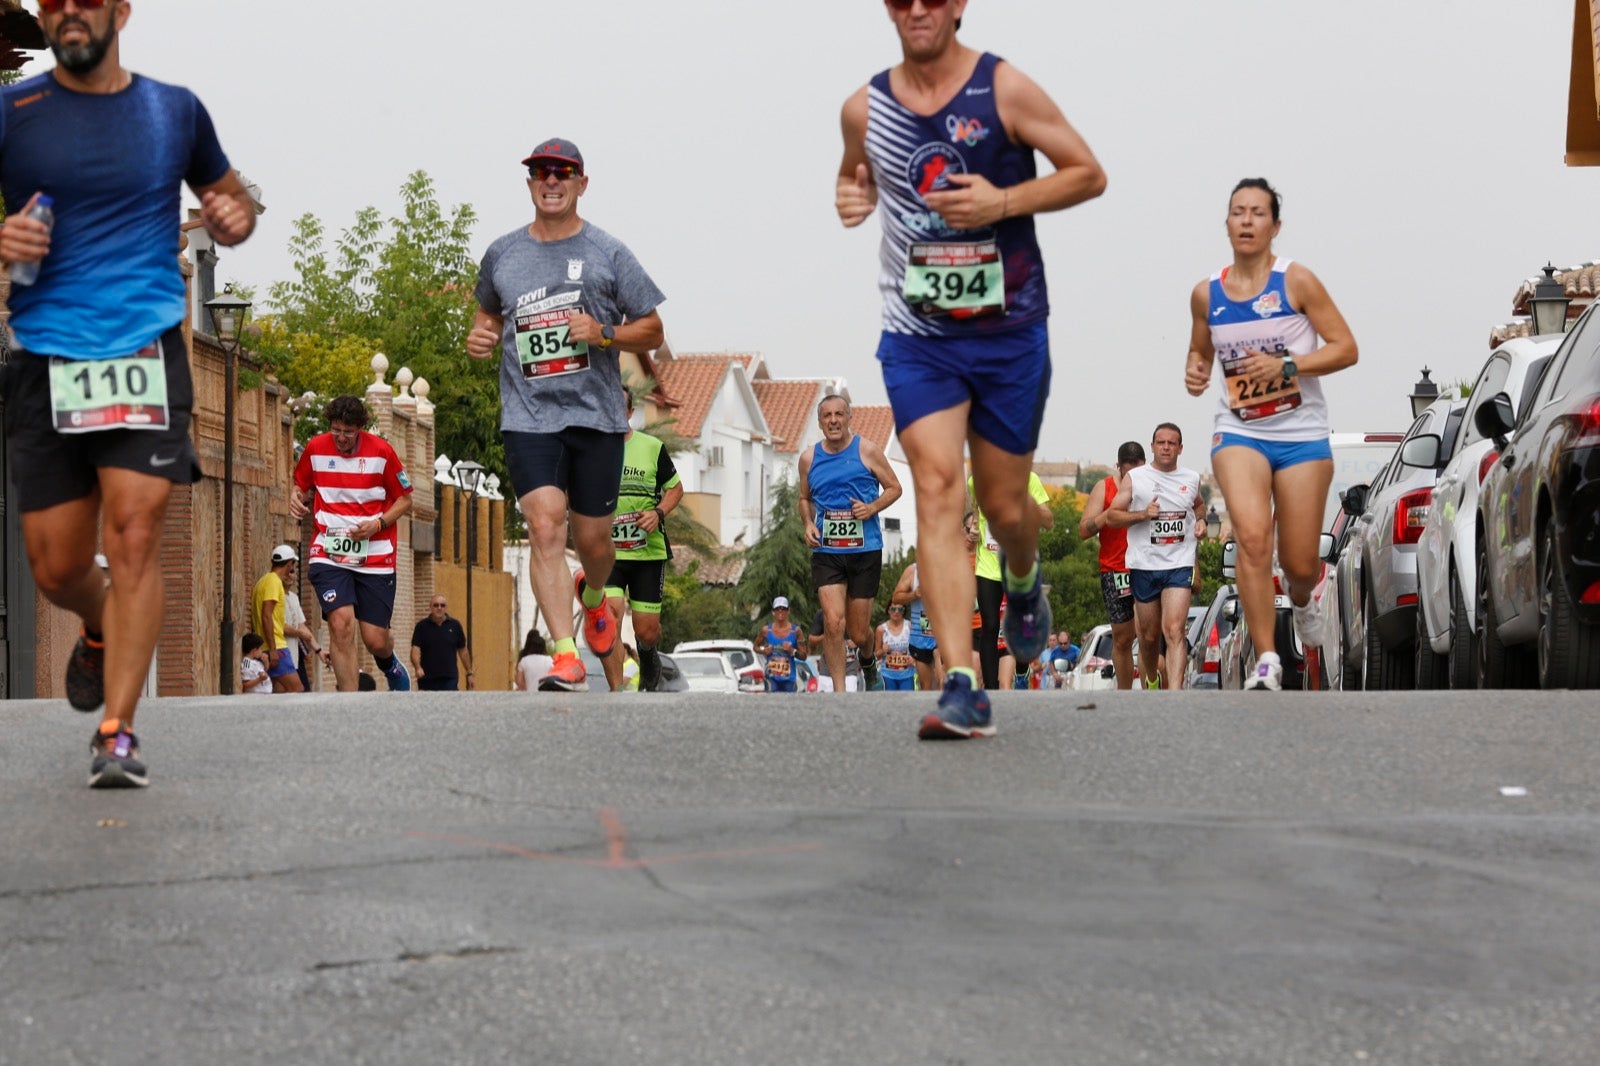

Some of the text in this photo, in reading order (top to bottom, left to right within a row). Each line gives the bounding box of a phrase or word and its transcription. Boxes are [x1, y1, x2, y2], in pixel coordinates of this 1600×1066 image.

[925, 270, 988, 301] 394
[517, 286, 548, 308] XXVII
[528, 332, 578, 356] 854
[1236, 336, 1285, 347] ATLETISMO
[74, 364, 148, 400] 110
[623, 465, 646, 478] bike
[829, 522, 857, 536] 282
[1155, 520, 1183, 533] 3040
[333, 538, 362, 553] 300
